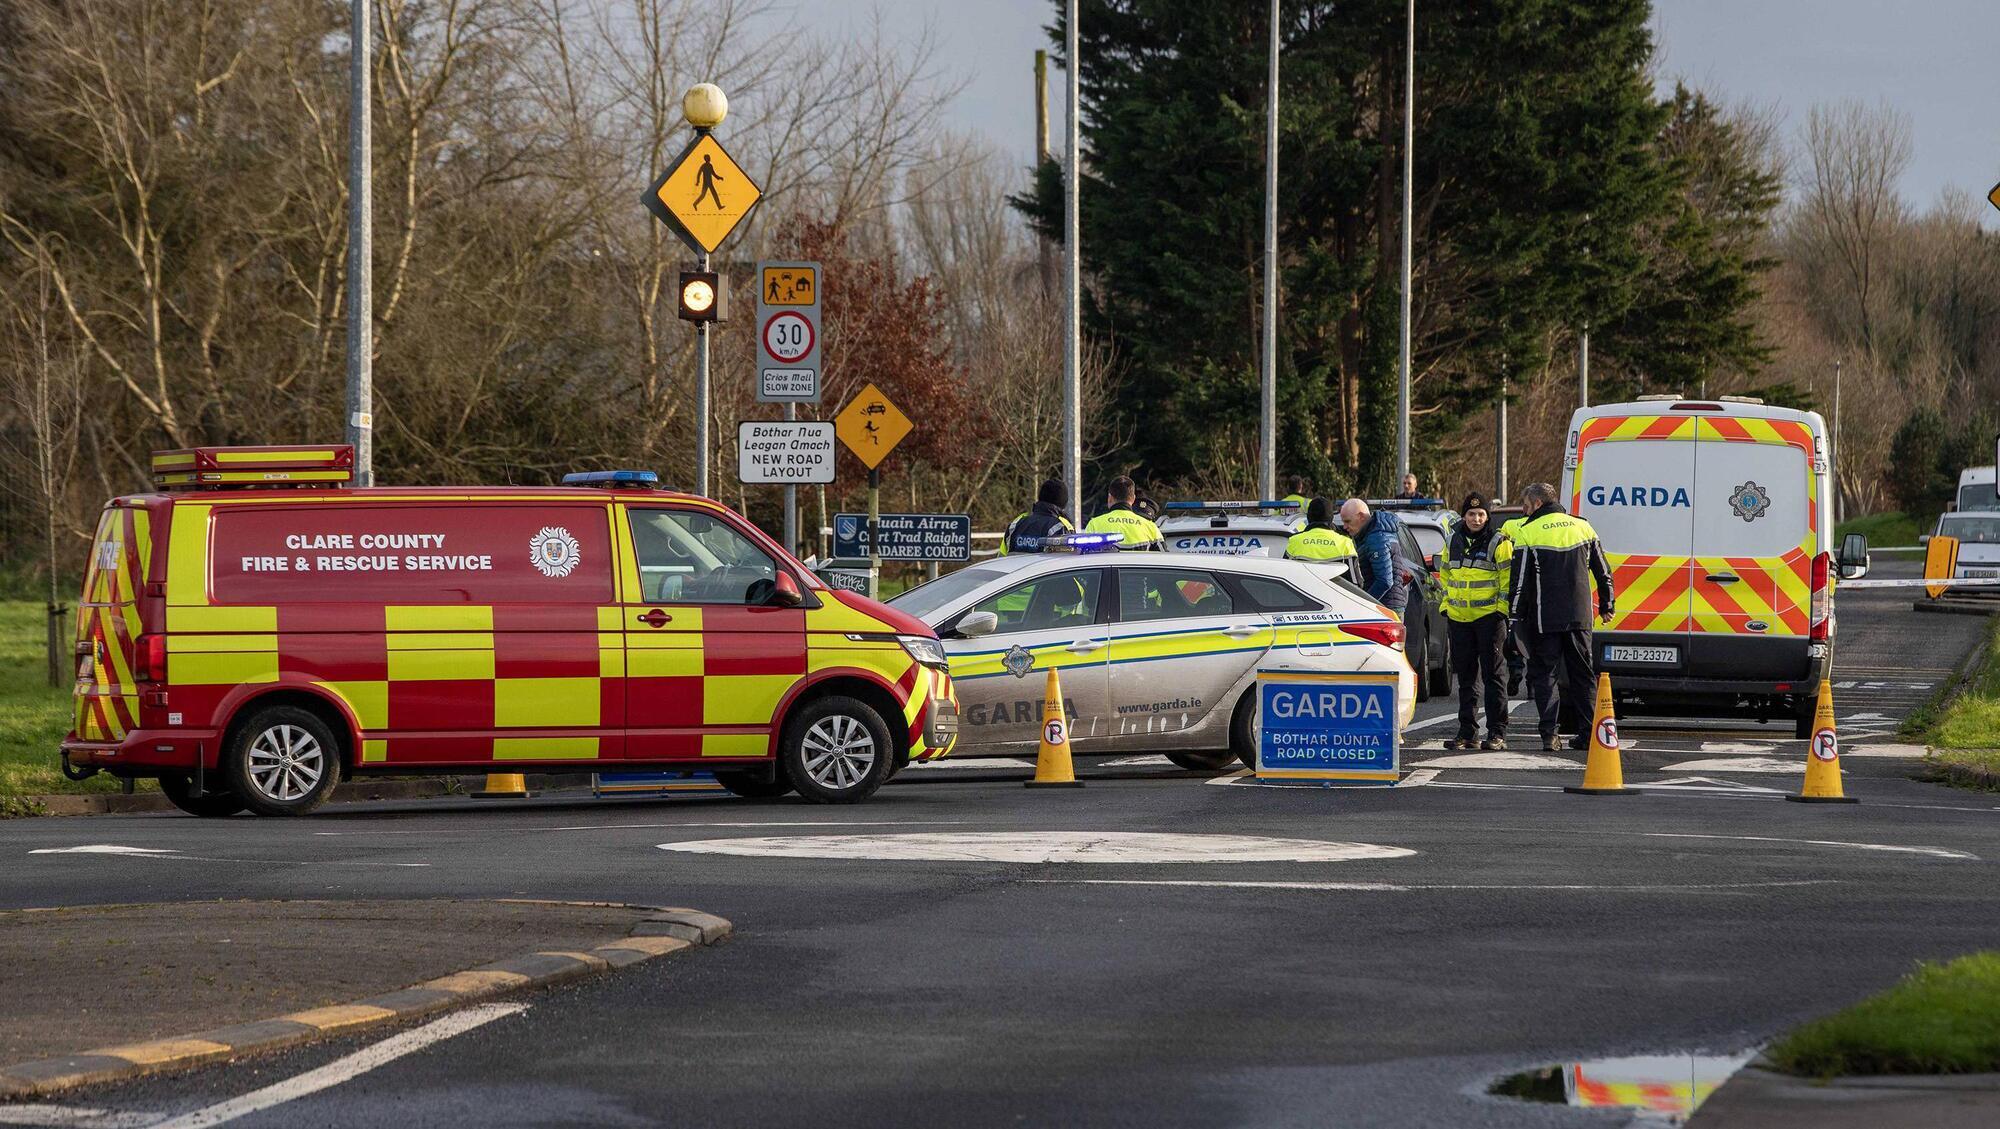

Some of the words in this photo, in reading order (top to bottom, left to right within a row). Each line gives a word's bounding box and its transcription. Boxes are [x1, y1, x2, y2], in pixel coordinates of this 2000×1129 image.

[777, 324, 802, 345] 30
[779, 347, 799, 355] km/h
[764, 373, 788, 382] Crios
[791, 373, 812, 382] Mall
[765, 383, 789, 392] SLOW
[790, 383, 812, 392] ZONE
[798, 427, 822, 438] Nua
[744, 440, 786, 452] Leagan
[790, 439, 830, 451] Amach
[752, 454, 782, 465] NEW
[787, 454, 823, 465] ROAD
[762, 467, 812, 478] LAYOUT
[1587, 486, 1691, 507] GARDA
[866, 517, 914, 529] luain
[917, 517, 958, 529] Airne
[1107, 516, 1142, 526] GARDA
[1542, 520, 1575, 530] GARDA
[285, 534, 355, 550] CLARE
[359, 534, 446, 549] COUNTY
[892, 531, 921, 543] Trad
[924, 532, 965, 546] Raighe
[1176, 537, 1262, 549] GARDA
[1302, 538, 1336, 547] GARDA
[95, 541, 121, 570] FIRE
[925, 545, 965, 558] COURT
[242, 556, 289, 572] FIRE
[295, 556, 310, 572] &
[317, 555, 399, 571] RESCUE
[405, 555, 492, 571] SERVICE
[1613, 649, 1673, 662] 172-D-23372
[966, 698, 1079, 726] GARA
[1117, 698, 1202, 715] www.garda.ie
[1271, 692, 1384, 719] GARDA
[1273, 731, 1328, 745] BÓTHAR
[1333, 732, 1380, 746] DÚNTA
[1277, 748, 1315, 758] ROAD
[1320, 748, 1376, 760] CLOSED
